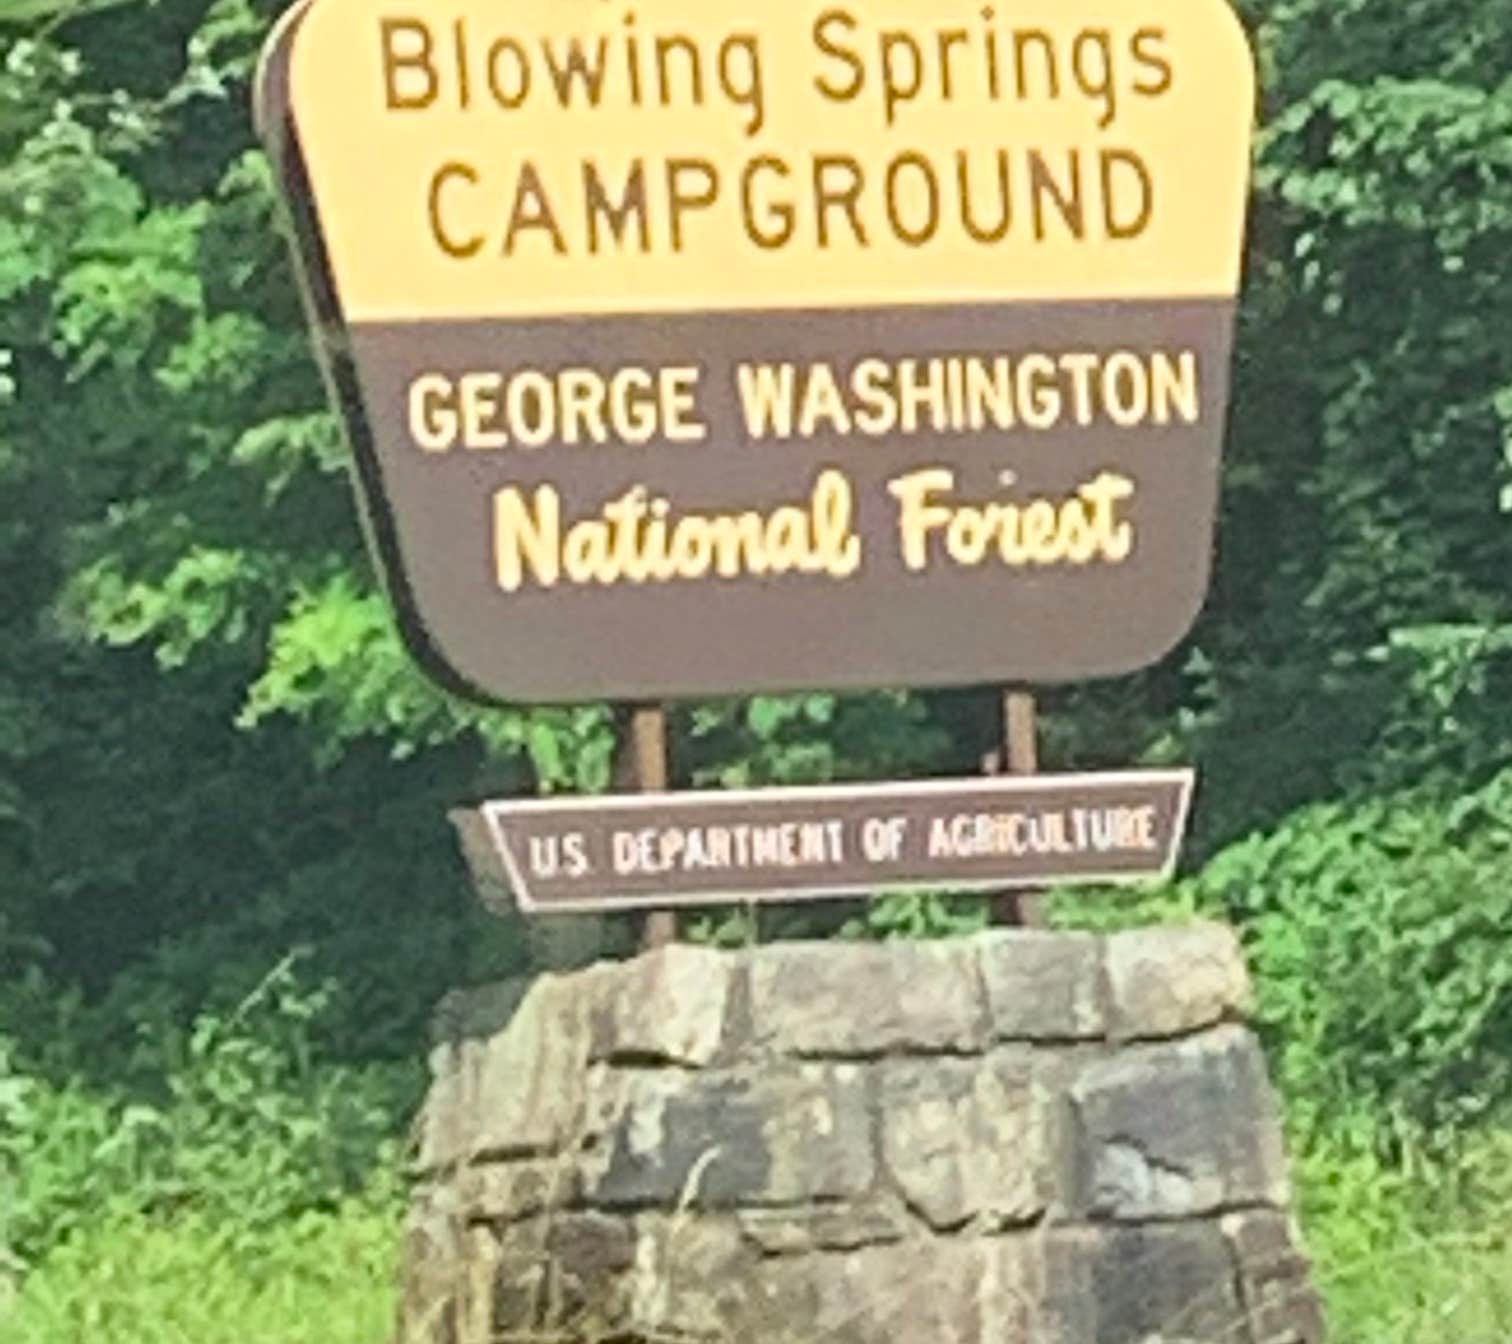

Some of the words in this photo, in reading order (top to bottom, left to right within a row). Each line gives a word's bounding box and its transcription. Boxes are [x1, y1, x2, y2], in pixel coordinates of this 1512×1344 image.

[377, 12, 764, 137] Blowing
[810, 4, 1174, 129] Springs
[426, 148, 1155, 260] CAMPGROUND
[408, 366, 707, 452] GEORGE
[737, 350, 1201, 440] WASHINGTON
[492, 468, 861, 592] National
[889, 468, 1136, 571] Forest
[612, 819, 844, 874] DEPARTMENT
[863, 816, 908, 862] OF
[927, 804, 1158, 858] AGRICULTURE
